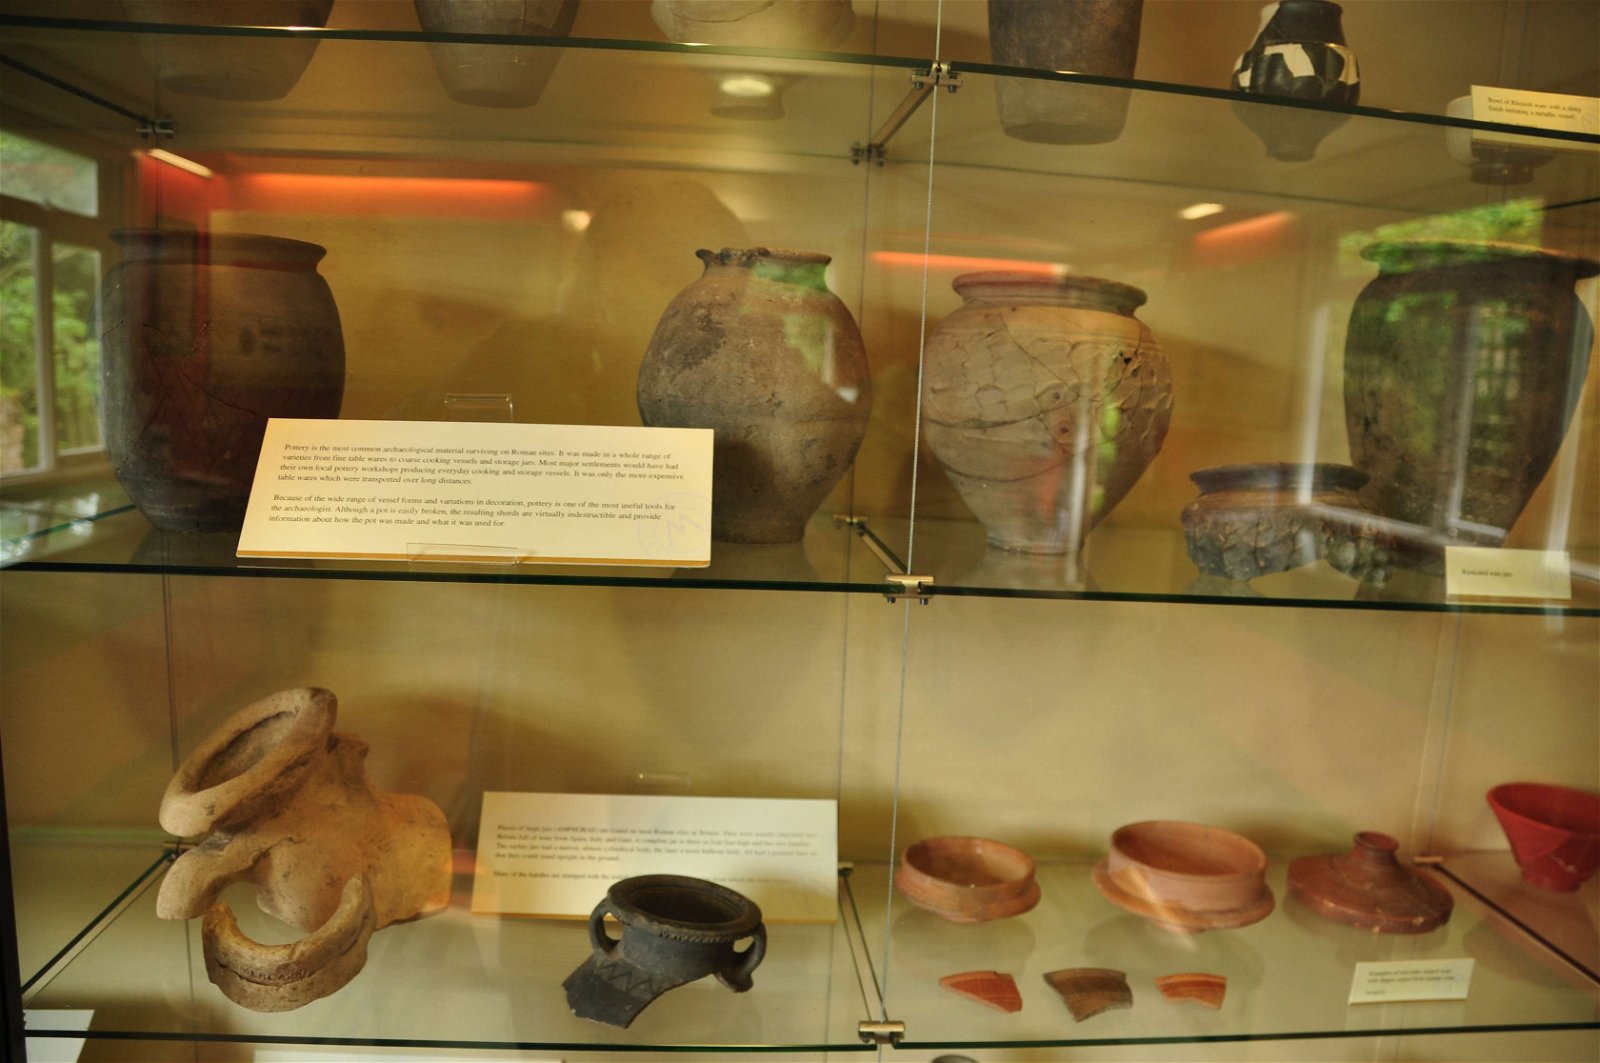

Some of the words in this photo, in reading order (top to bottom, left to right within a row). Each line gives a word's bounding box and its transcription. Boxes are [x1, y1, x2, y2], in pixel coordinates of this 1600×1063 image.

[286, 443, 309, 453] Pottery
[383, 446, 434, 456] archaeological
[435, 447, 464, 455] material
[465, 447, 498, 457] surviving
[511, 448, 536, 456] Roman
[284, 453, 311, 461] varieties
[422, 456, 450, 466] cooking
[452, 457, 477, 465] vessels
[494, 458, 519, 467] storage
[559, 459, 579, 469] major
[581, 460, 621, 468] settlements
[623, 461, 644, 469] would
[319, 474, 341, 482] which
[362, 475, 401, 484] transported
[420, 476, 436, 485] long
[438, 476, 472, 484] distances.
[334, 464, 358, 474] pottery
[360, 465, 398, 475] workshops
[400, 466, 435, 476] producing
[437, 466, 469, 476] everyday
[471, 467, 499, 477] cooking
[517, 468, 542, 478] storage
[597, 470, 613, 480] only
[649, 471, 684, 481] expensive
[274, 493, 302, 502] Because
[378, 496, 399, 504] vessel
[401, 496, 422, 504] forms
[439, 497, 474, 505] variations
[527, 499, 552, 509] pottery
[621, 501, 642, 509] useful
[269, 514, 310, 522] information
[312, 515, 332, 523] about
[364, 516, 376, 525] pot
[334, 505, 368, 515] Although
[376, 506, 387, 515] pot
[398, 506, 418, 516] easily
[463, 508, 494, 517] resulting
[496, 508, 519, 516] sherds
[535, 509, 565, 519] virtually
[567, 510, 616, 518] indestructible
[634, 511, 661, 521] provide
